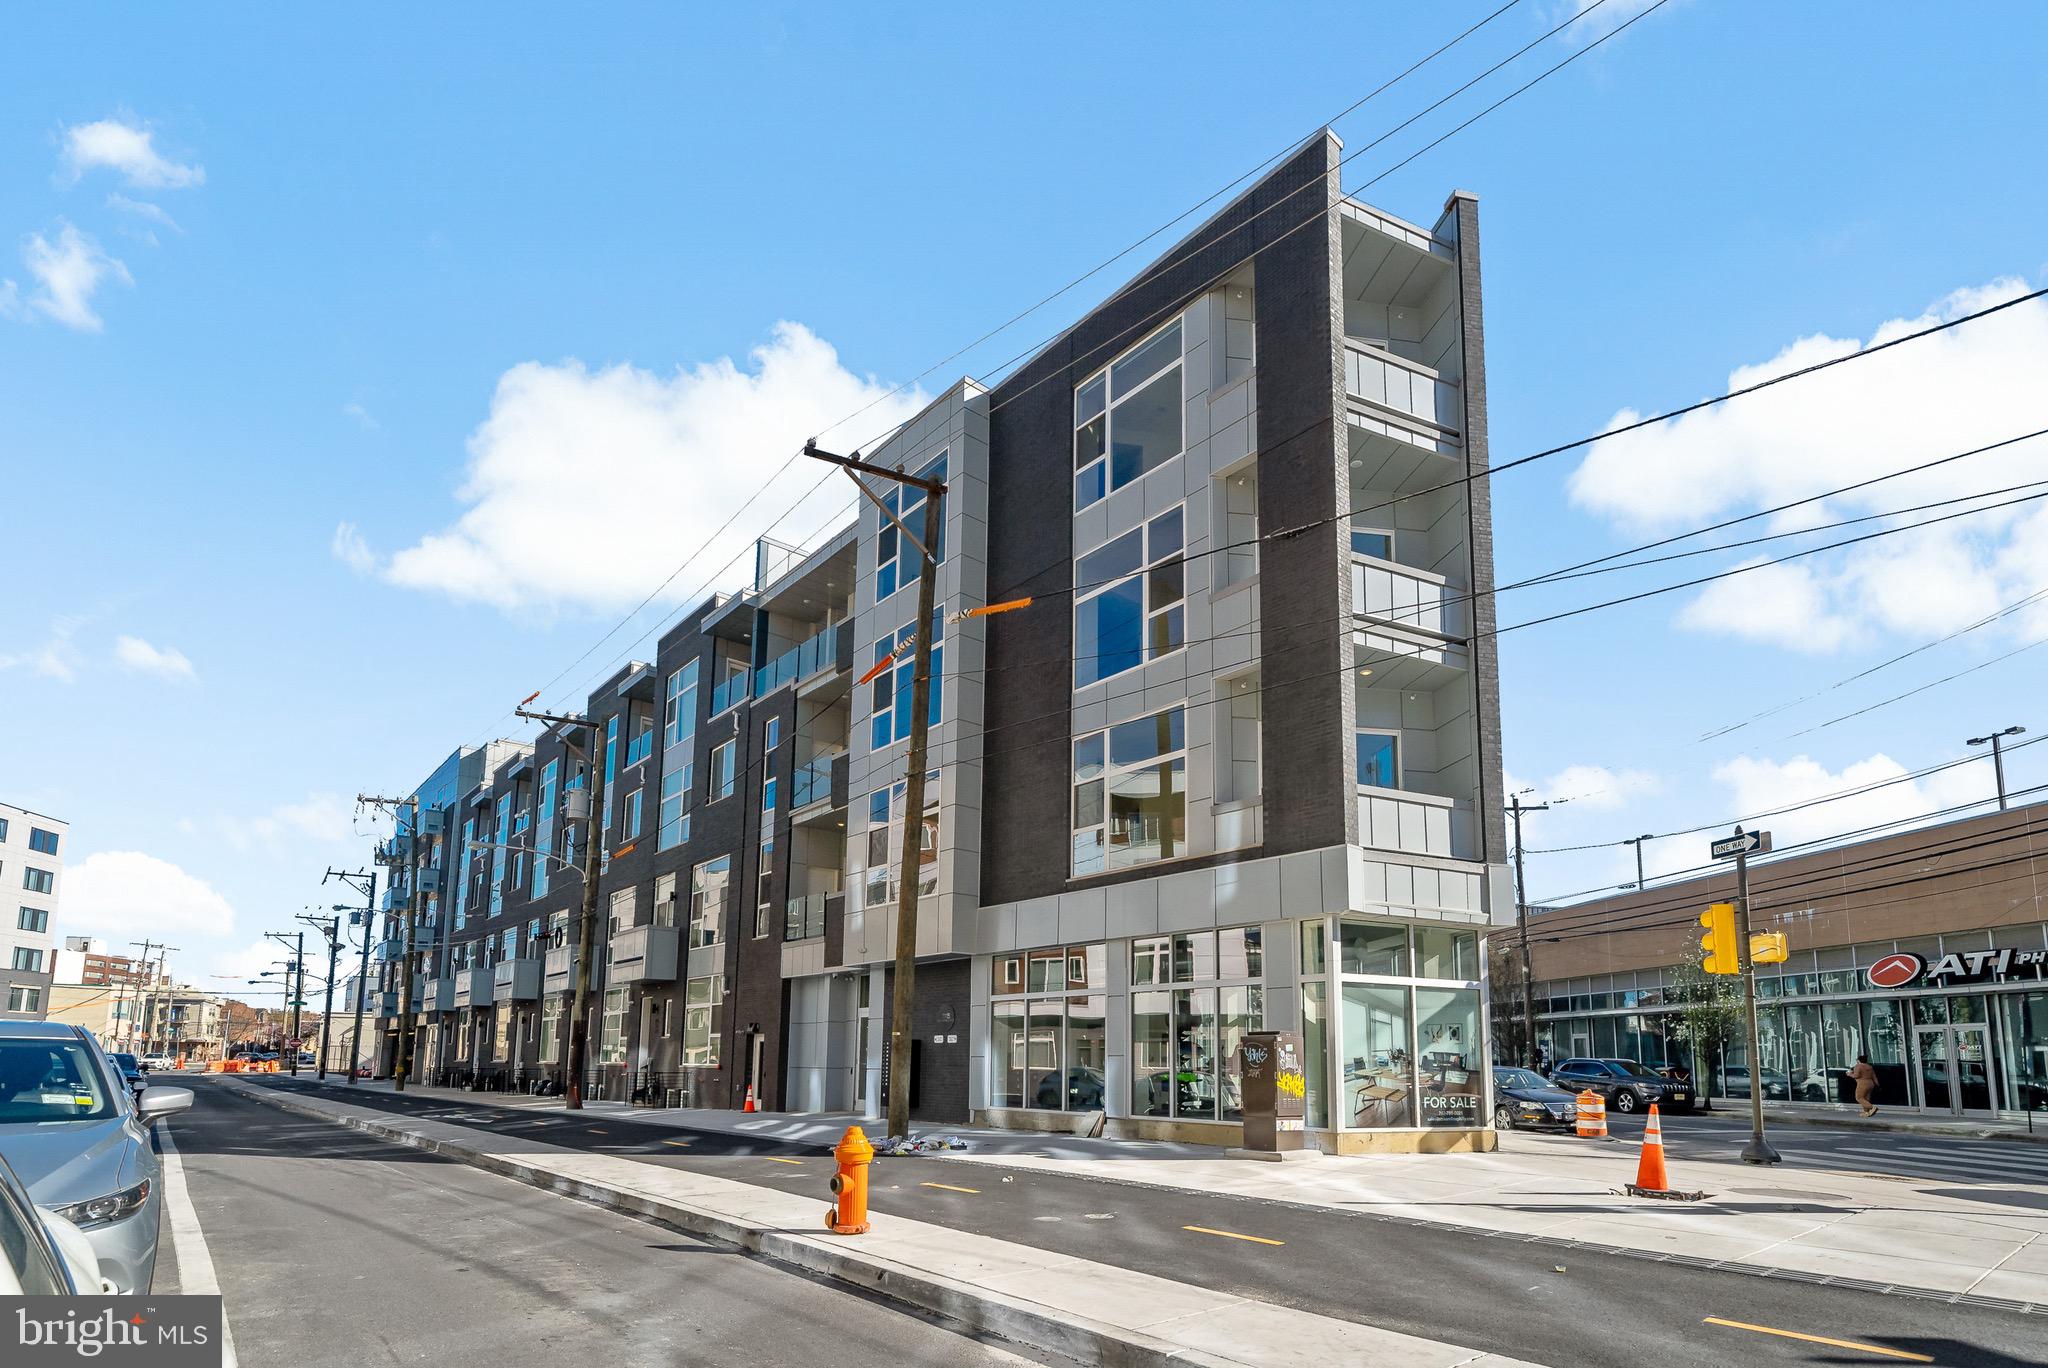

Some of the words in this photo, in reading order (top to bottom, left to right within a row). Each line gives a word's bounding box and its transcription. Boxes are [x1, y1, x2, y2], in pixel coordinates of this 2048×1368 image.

[1716, 843, 1730, 853] ONE
[1731, 839, 1746, 849] WAY
[1927, 949, 2012, 978] ATI
[2018, 951, 2048, 965] PH
[1423, 1096, 1447, 1109] FOR
[1449, 1096, 1477, 1109] SALE
